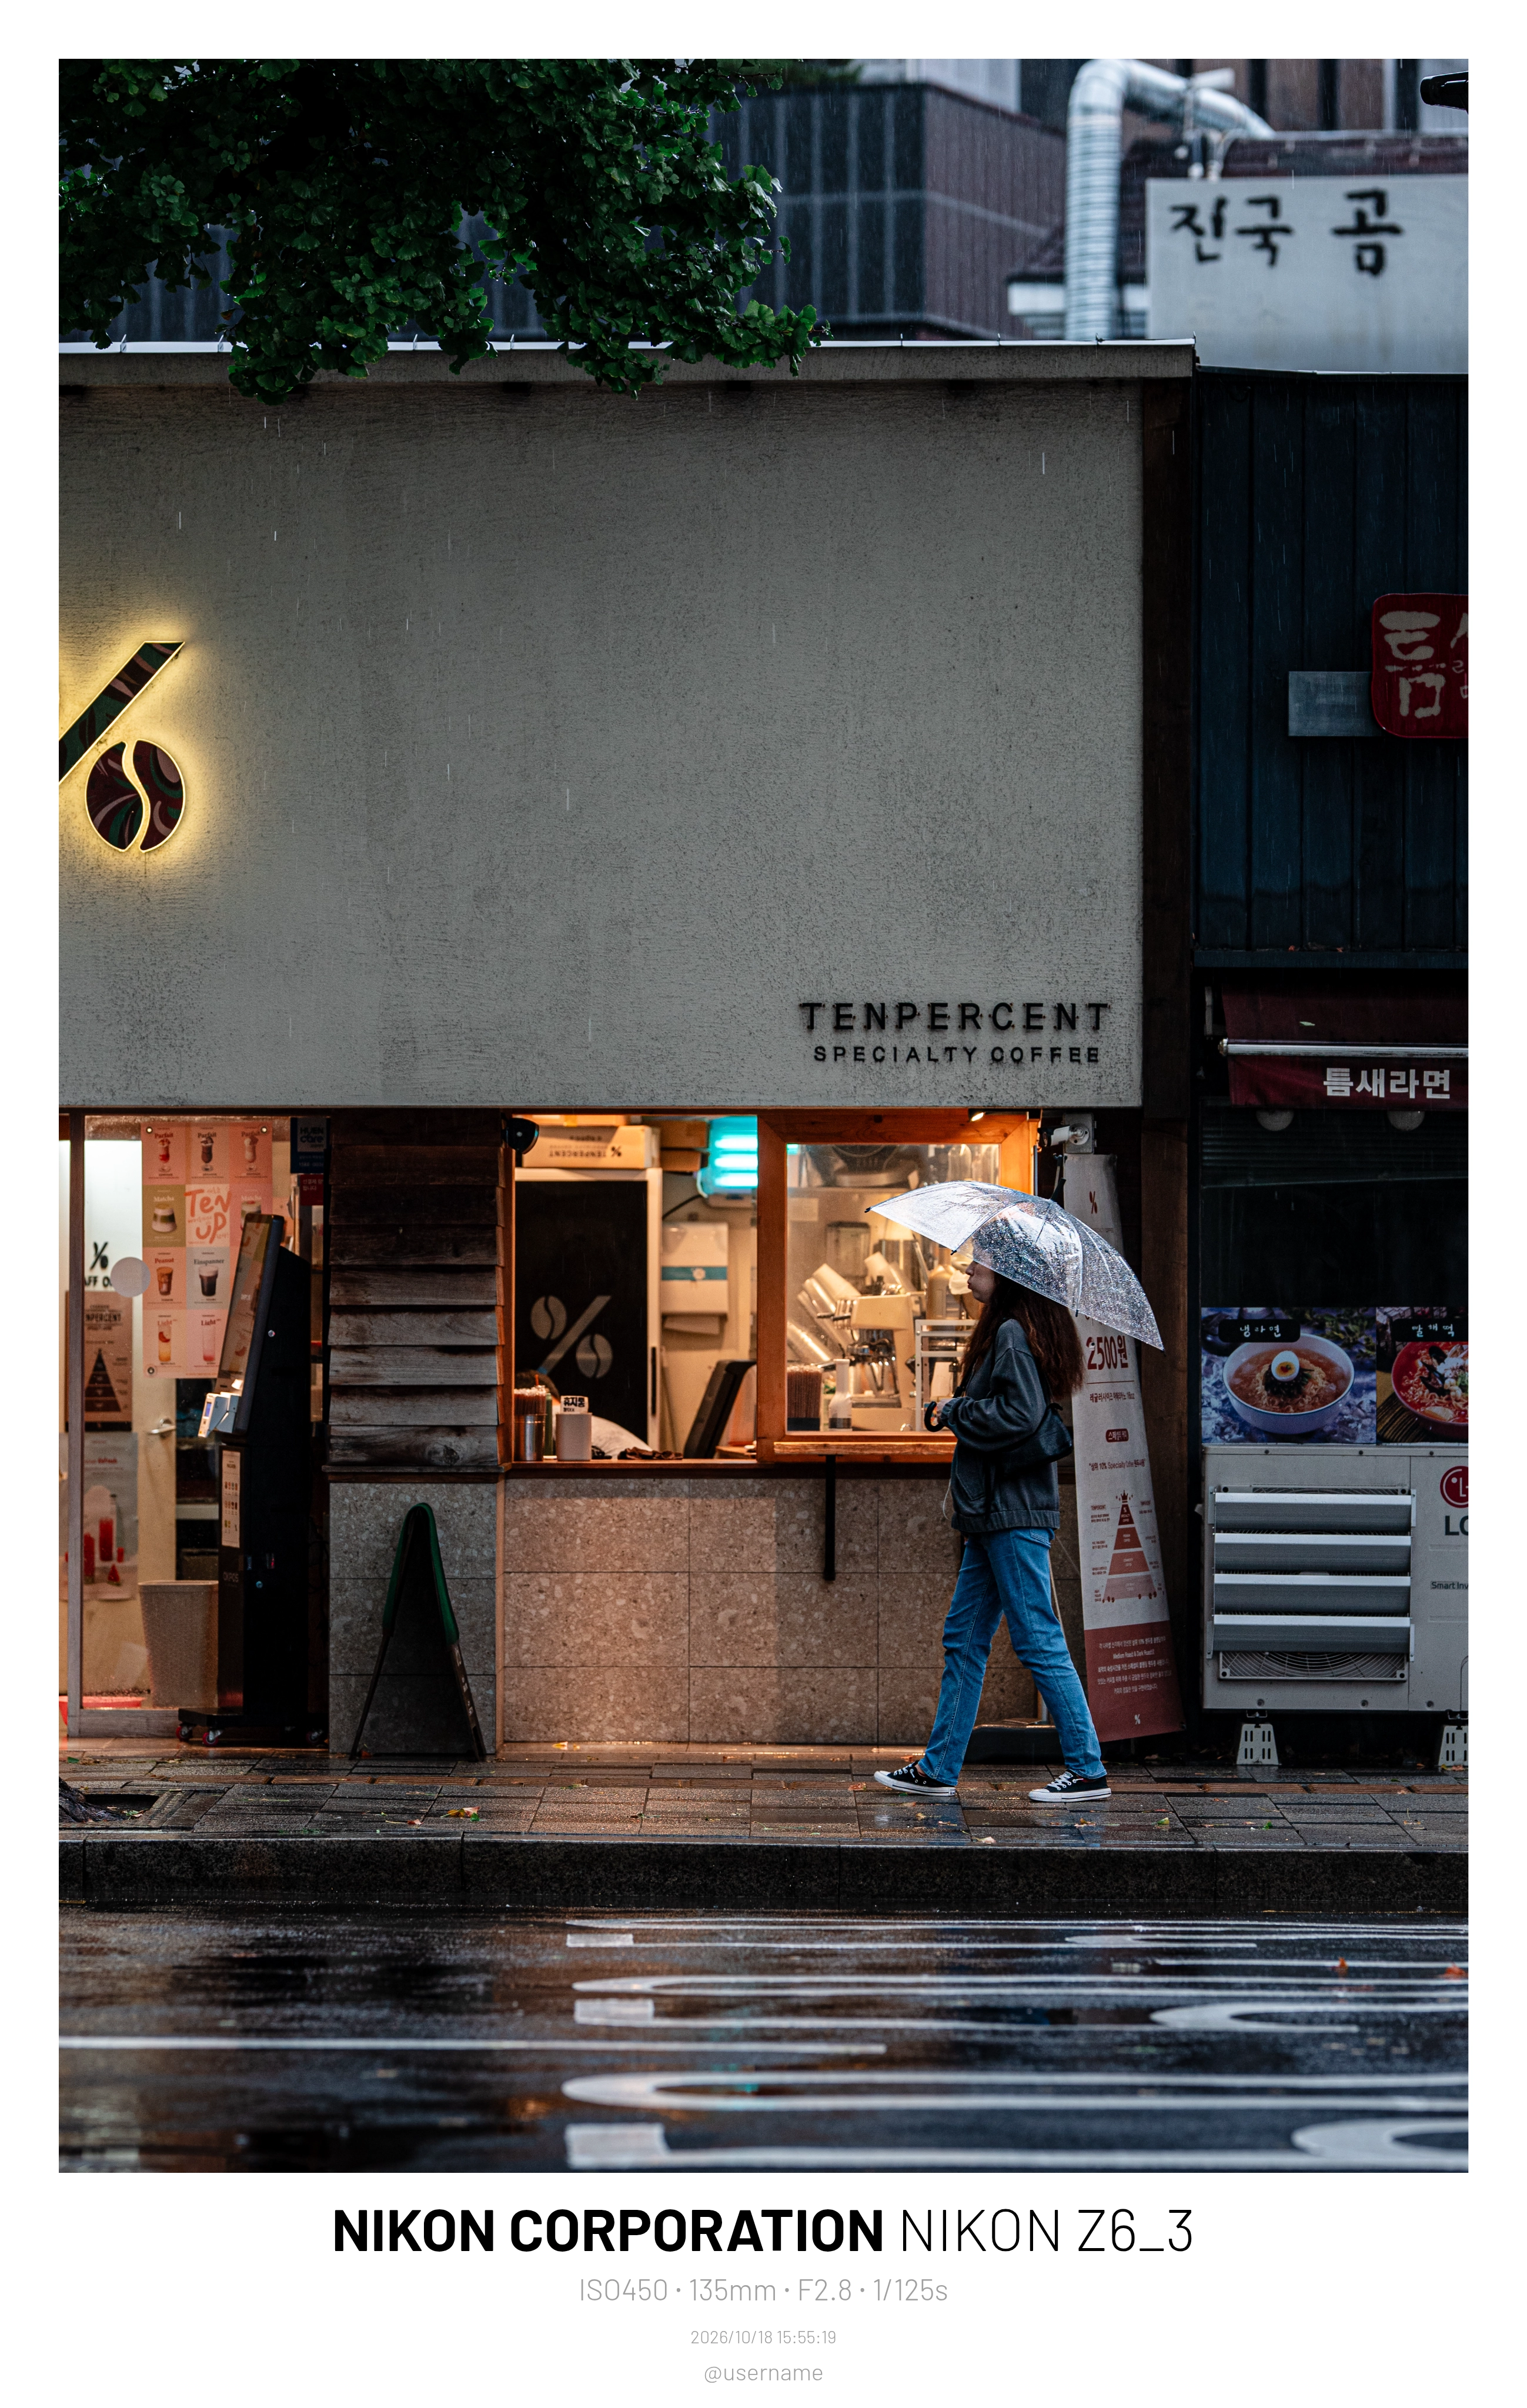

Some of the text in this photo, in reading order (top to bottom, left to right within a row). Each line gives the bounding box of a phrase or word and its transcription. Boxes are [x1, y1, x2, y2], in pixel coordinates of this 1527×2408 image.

[1170, 188, 1403, 277] 진국 곰
[800, 1002, 1110, 1031] TENPERCENT
[814, 1046, 1100, 1063] SPECIALTY COFFEE
[1323, 1067, 1451, 1099] 틈새라면
[1086, 1335, 1129, 1370] 2500원
[1431, 1581, 1455, 1590] Smart
